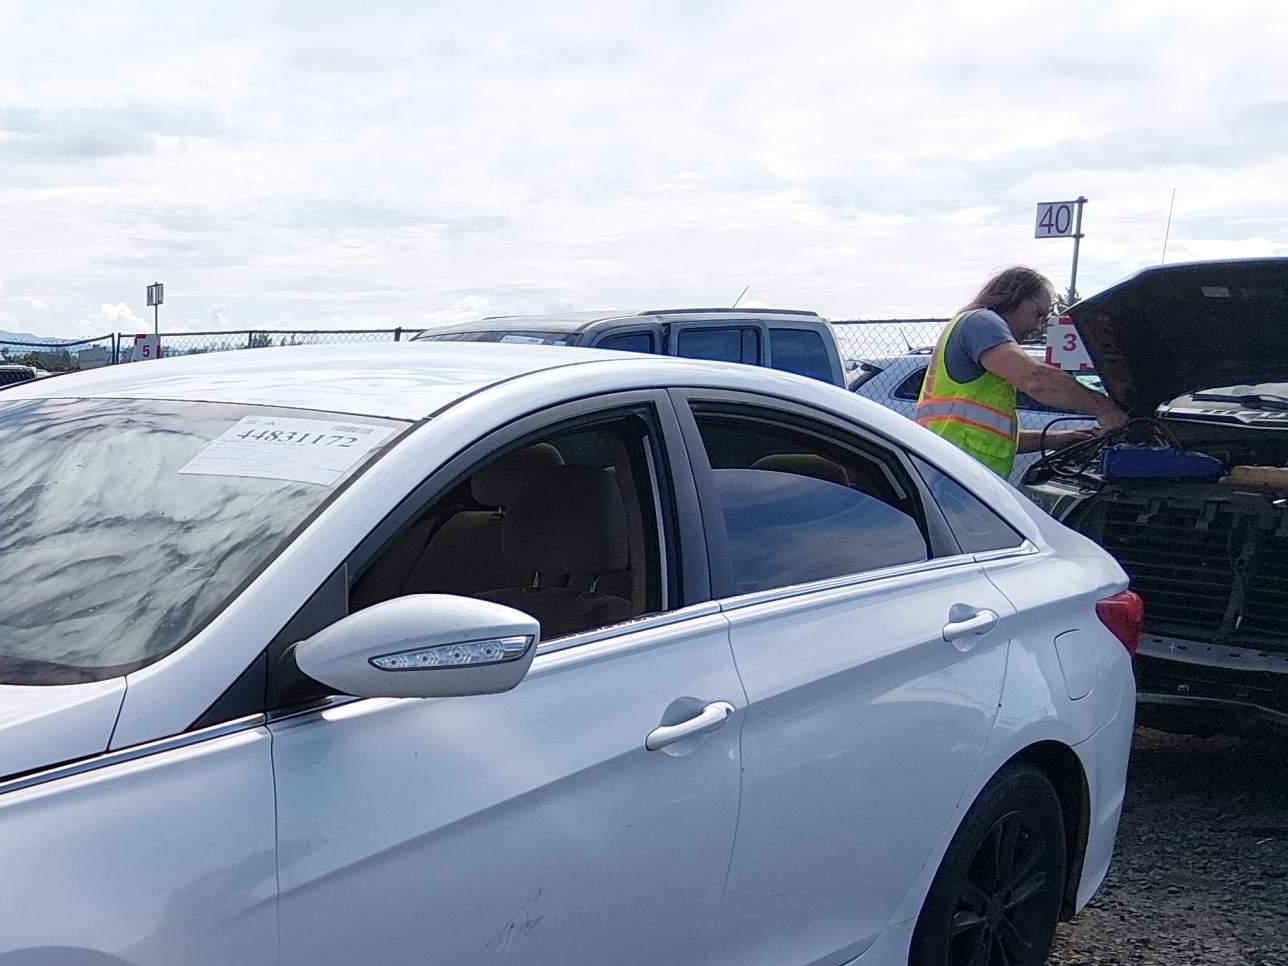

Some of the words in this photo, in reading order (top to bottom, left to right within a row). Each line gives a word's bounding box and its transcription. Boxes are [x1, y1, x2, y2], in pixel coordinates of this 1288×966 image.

[1039, 204, 1071, 234] 40
[142, 345, 151, 358] 5
[1062, 333, 1078, 352] 3
[237, 428, 359, 447] 44831172
